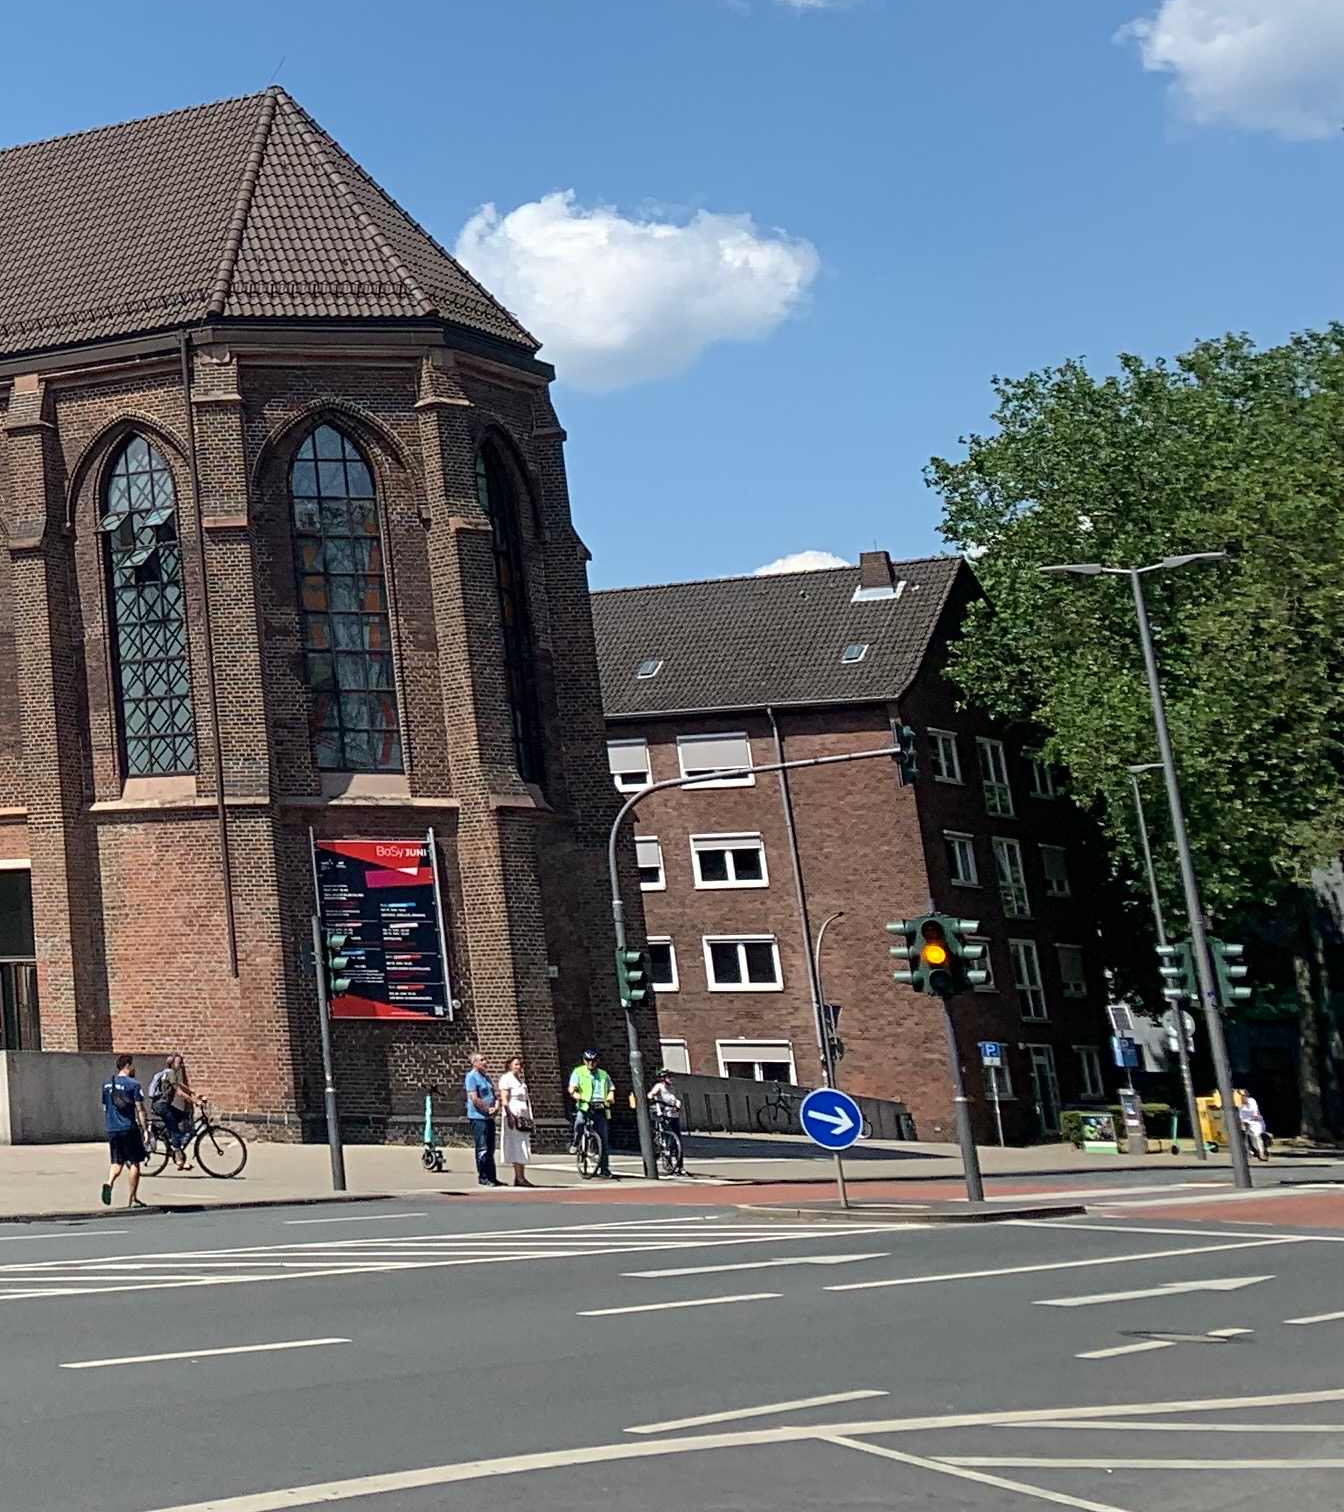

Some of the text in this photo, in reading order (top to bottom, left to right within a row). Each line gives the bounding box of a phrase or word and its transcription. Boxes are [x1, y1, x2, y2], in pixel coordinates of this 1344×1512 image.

[376, 845, 427, 858] BoSy JUNI
[985, 1044, 996, 1057] P
